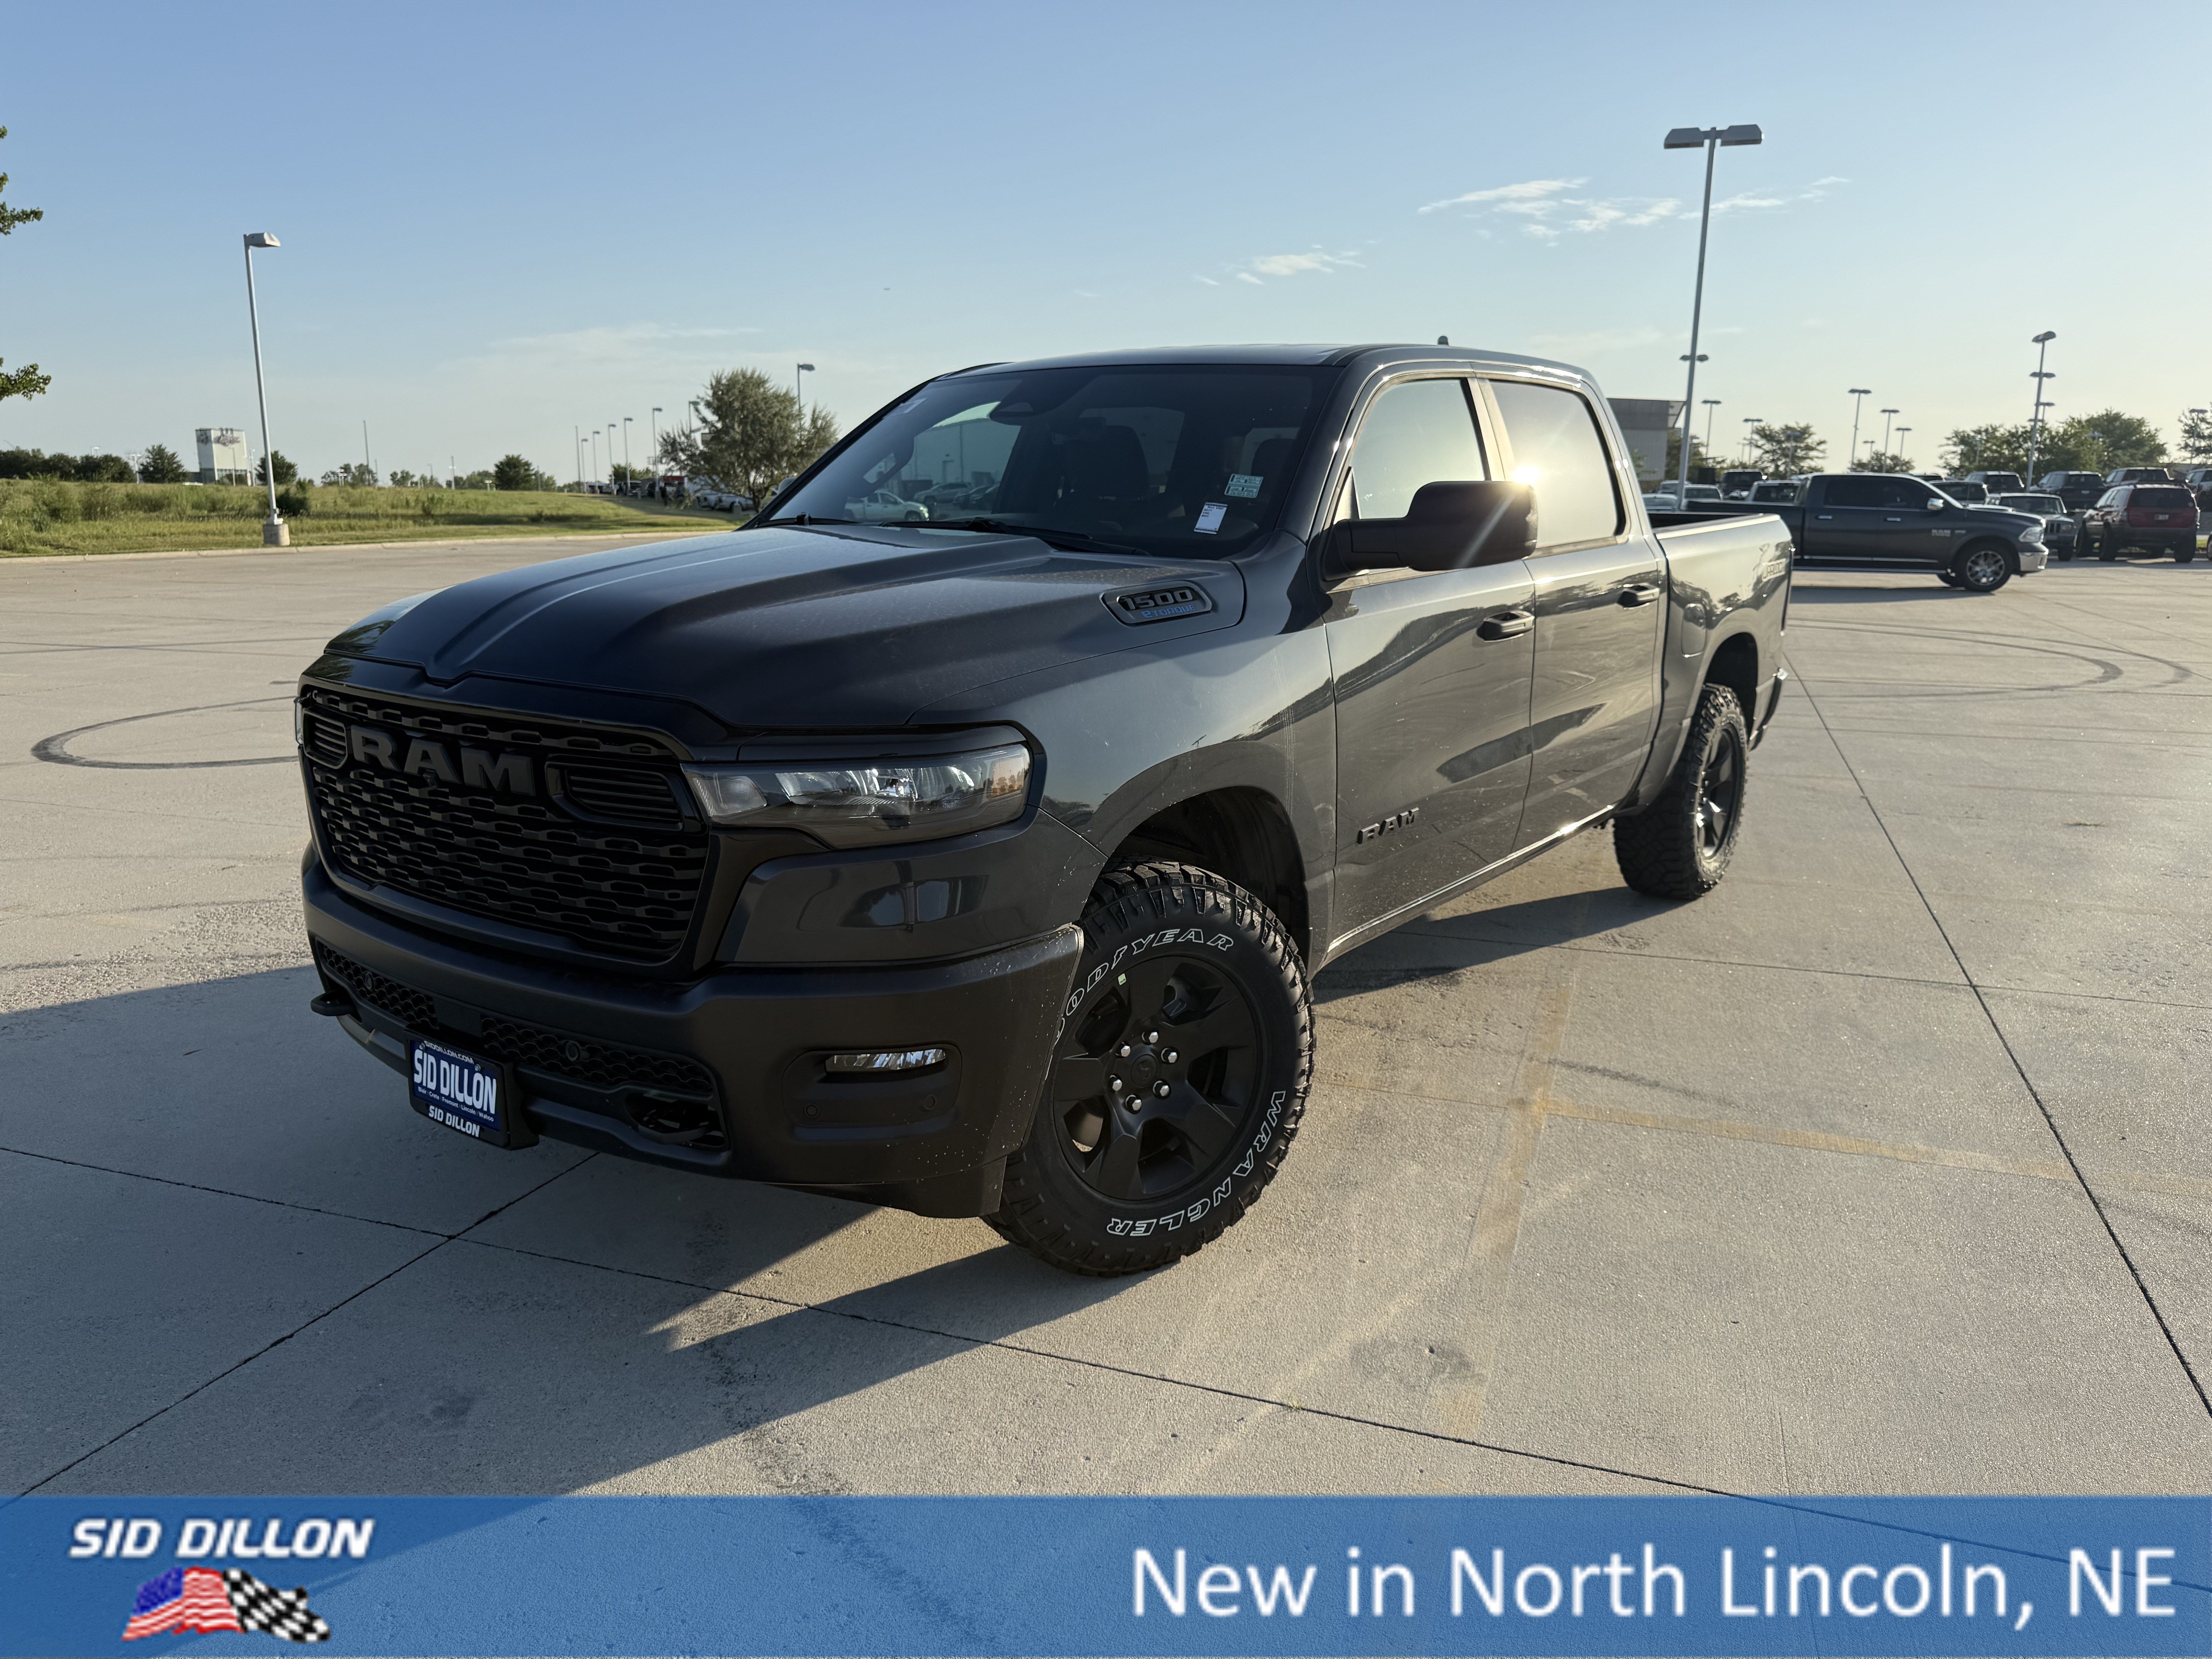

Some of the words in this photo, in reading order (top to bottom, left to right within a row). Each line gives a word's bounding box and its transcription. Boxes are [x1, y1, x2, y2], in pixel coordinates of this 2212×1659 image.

[1120, 589, 1193, 610] 1500
[351, 725, 536, 796] RAM
[1357, 807, 1420, 845] RAM
[1044, 928, 1234, 1080] ODYEAR
[424, 1040, 474, 1065] SIDDILLON.COM
[414, 1049, 437, 1091] SID
[440, 1060, 497, 1114] DILLON
[429, 1105, 444, 1122] SID
[445, 1112, 480, 1137] DILLON
[461, 1104, 476, 1115] Lincoln
[1106, 1090, 1286, 1236] WRANGLER
